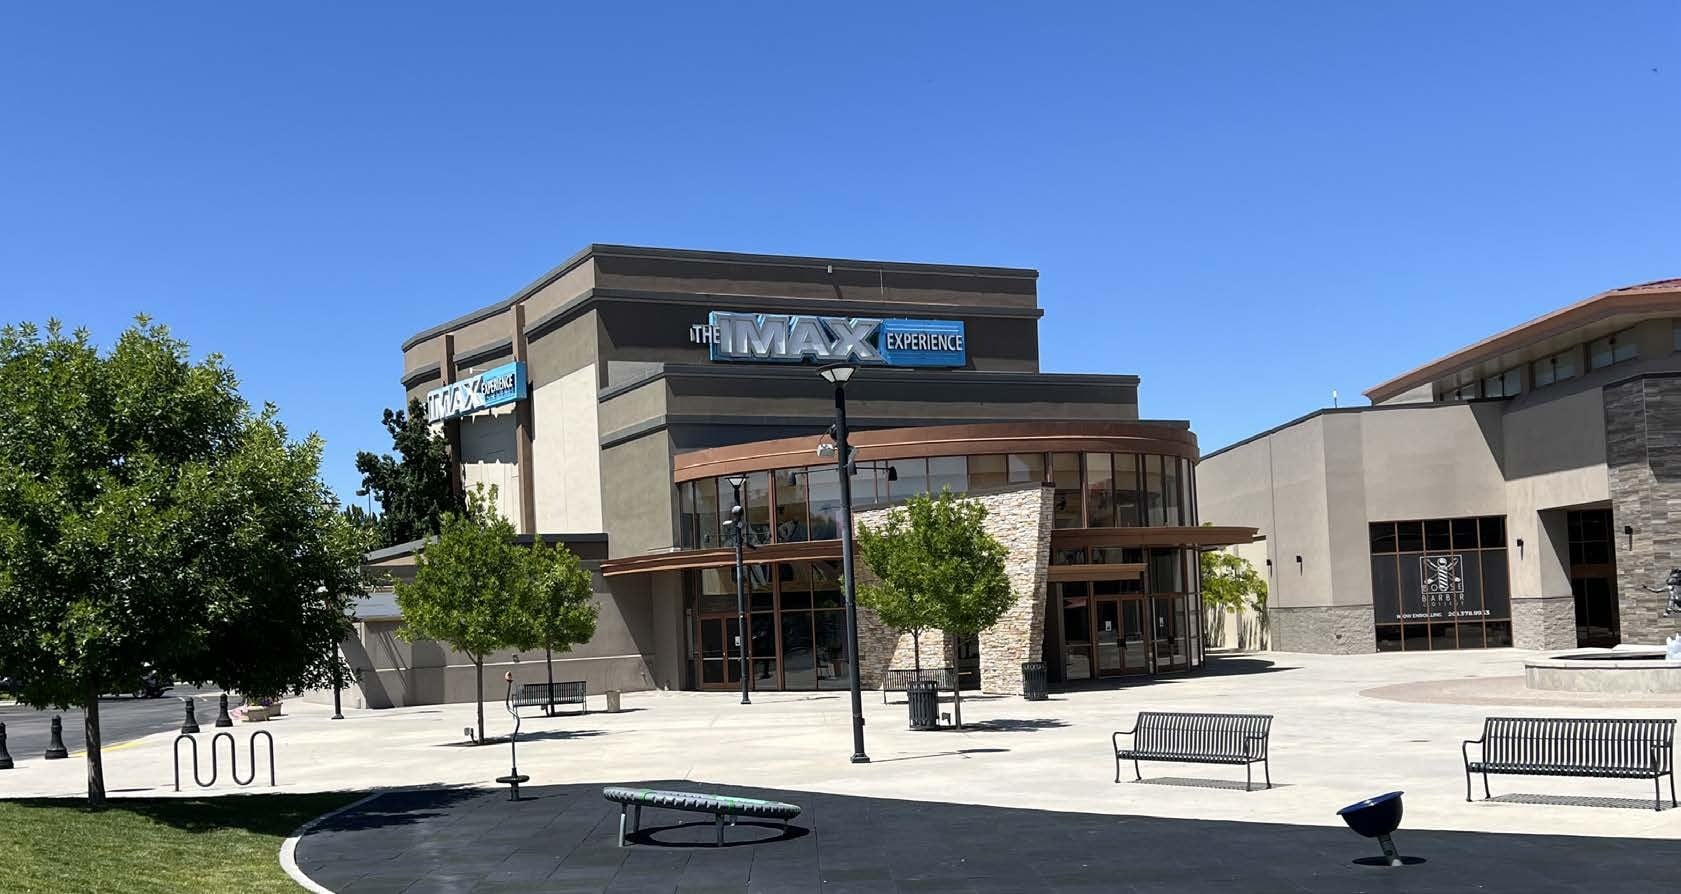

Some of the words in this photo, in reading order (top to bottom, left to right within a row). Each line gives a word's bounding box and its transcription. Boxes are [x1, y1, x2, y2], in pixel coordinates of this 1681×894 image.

[692, 324, 720, 343] THE
[719, 315, 880, 357] IMAX
[886, 333, 963, 351] EXPERIENCE
[428, 378, 483, 421] IMAX
[482, 375, 513, 394] EXPERIENCE
[1422, 593, 1464, 602] BARBR
